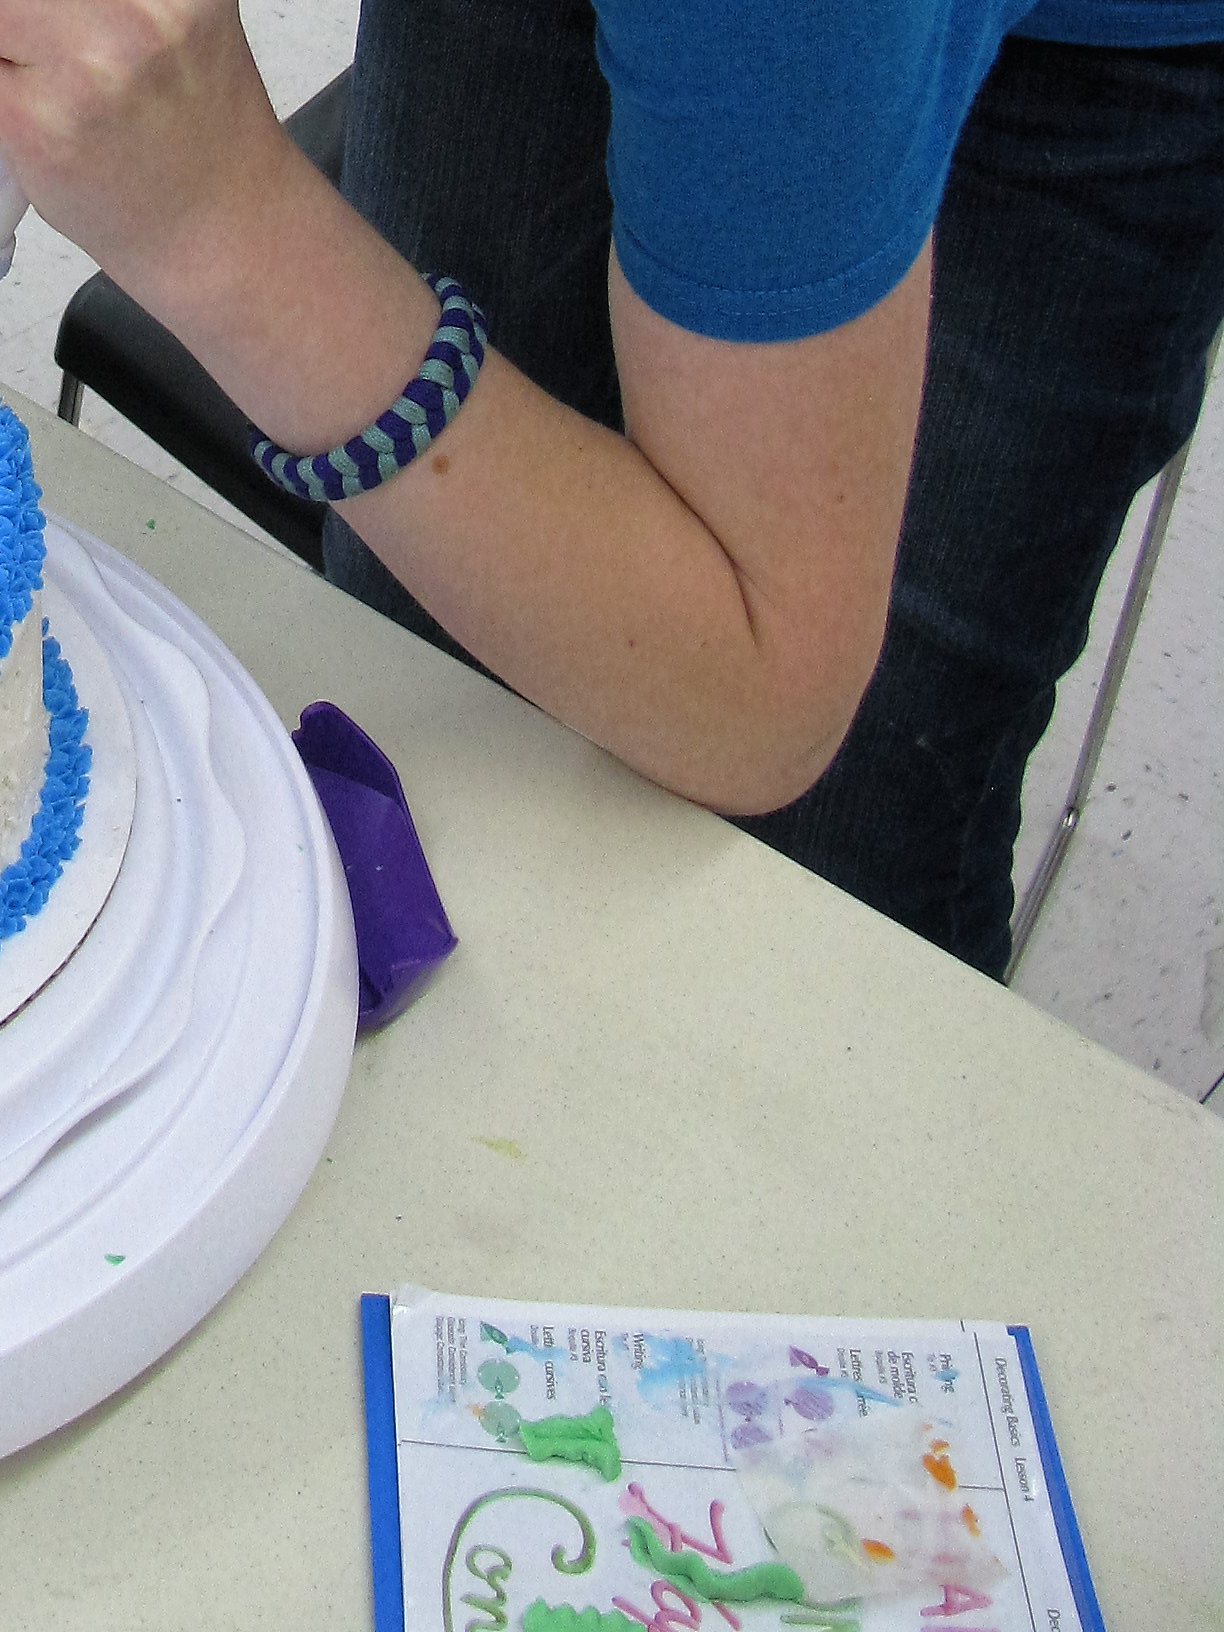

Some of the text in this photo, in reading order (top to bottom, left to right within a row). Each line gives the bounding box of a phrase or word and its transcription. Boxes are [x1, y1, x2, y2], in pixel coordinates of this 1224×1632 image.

[581, 1328, 595, 1363] cursiva
[595, 1330, 609, 1372] Escritura
[545, 1360, 559, 1402] cursives
[887, 1351, 907, 1399] de molde
[994, 1357, 1015, 1415] Decorating
[1006, 1415, 1023, 1447] Basics
[1015, 1457, 1031, 1492] Lesson
